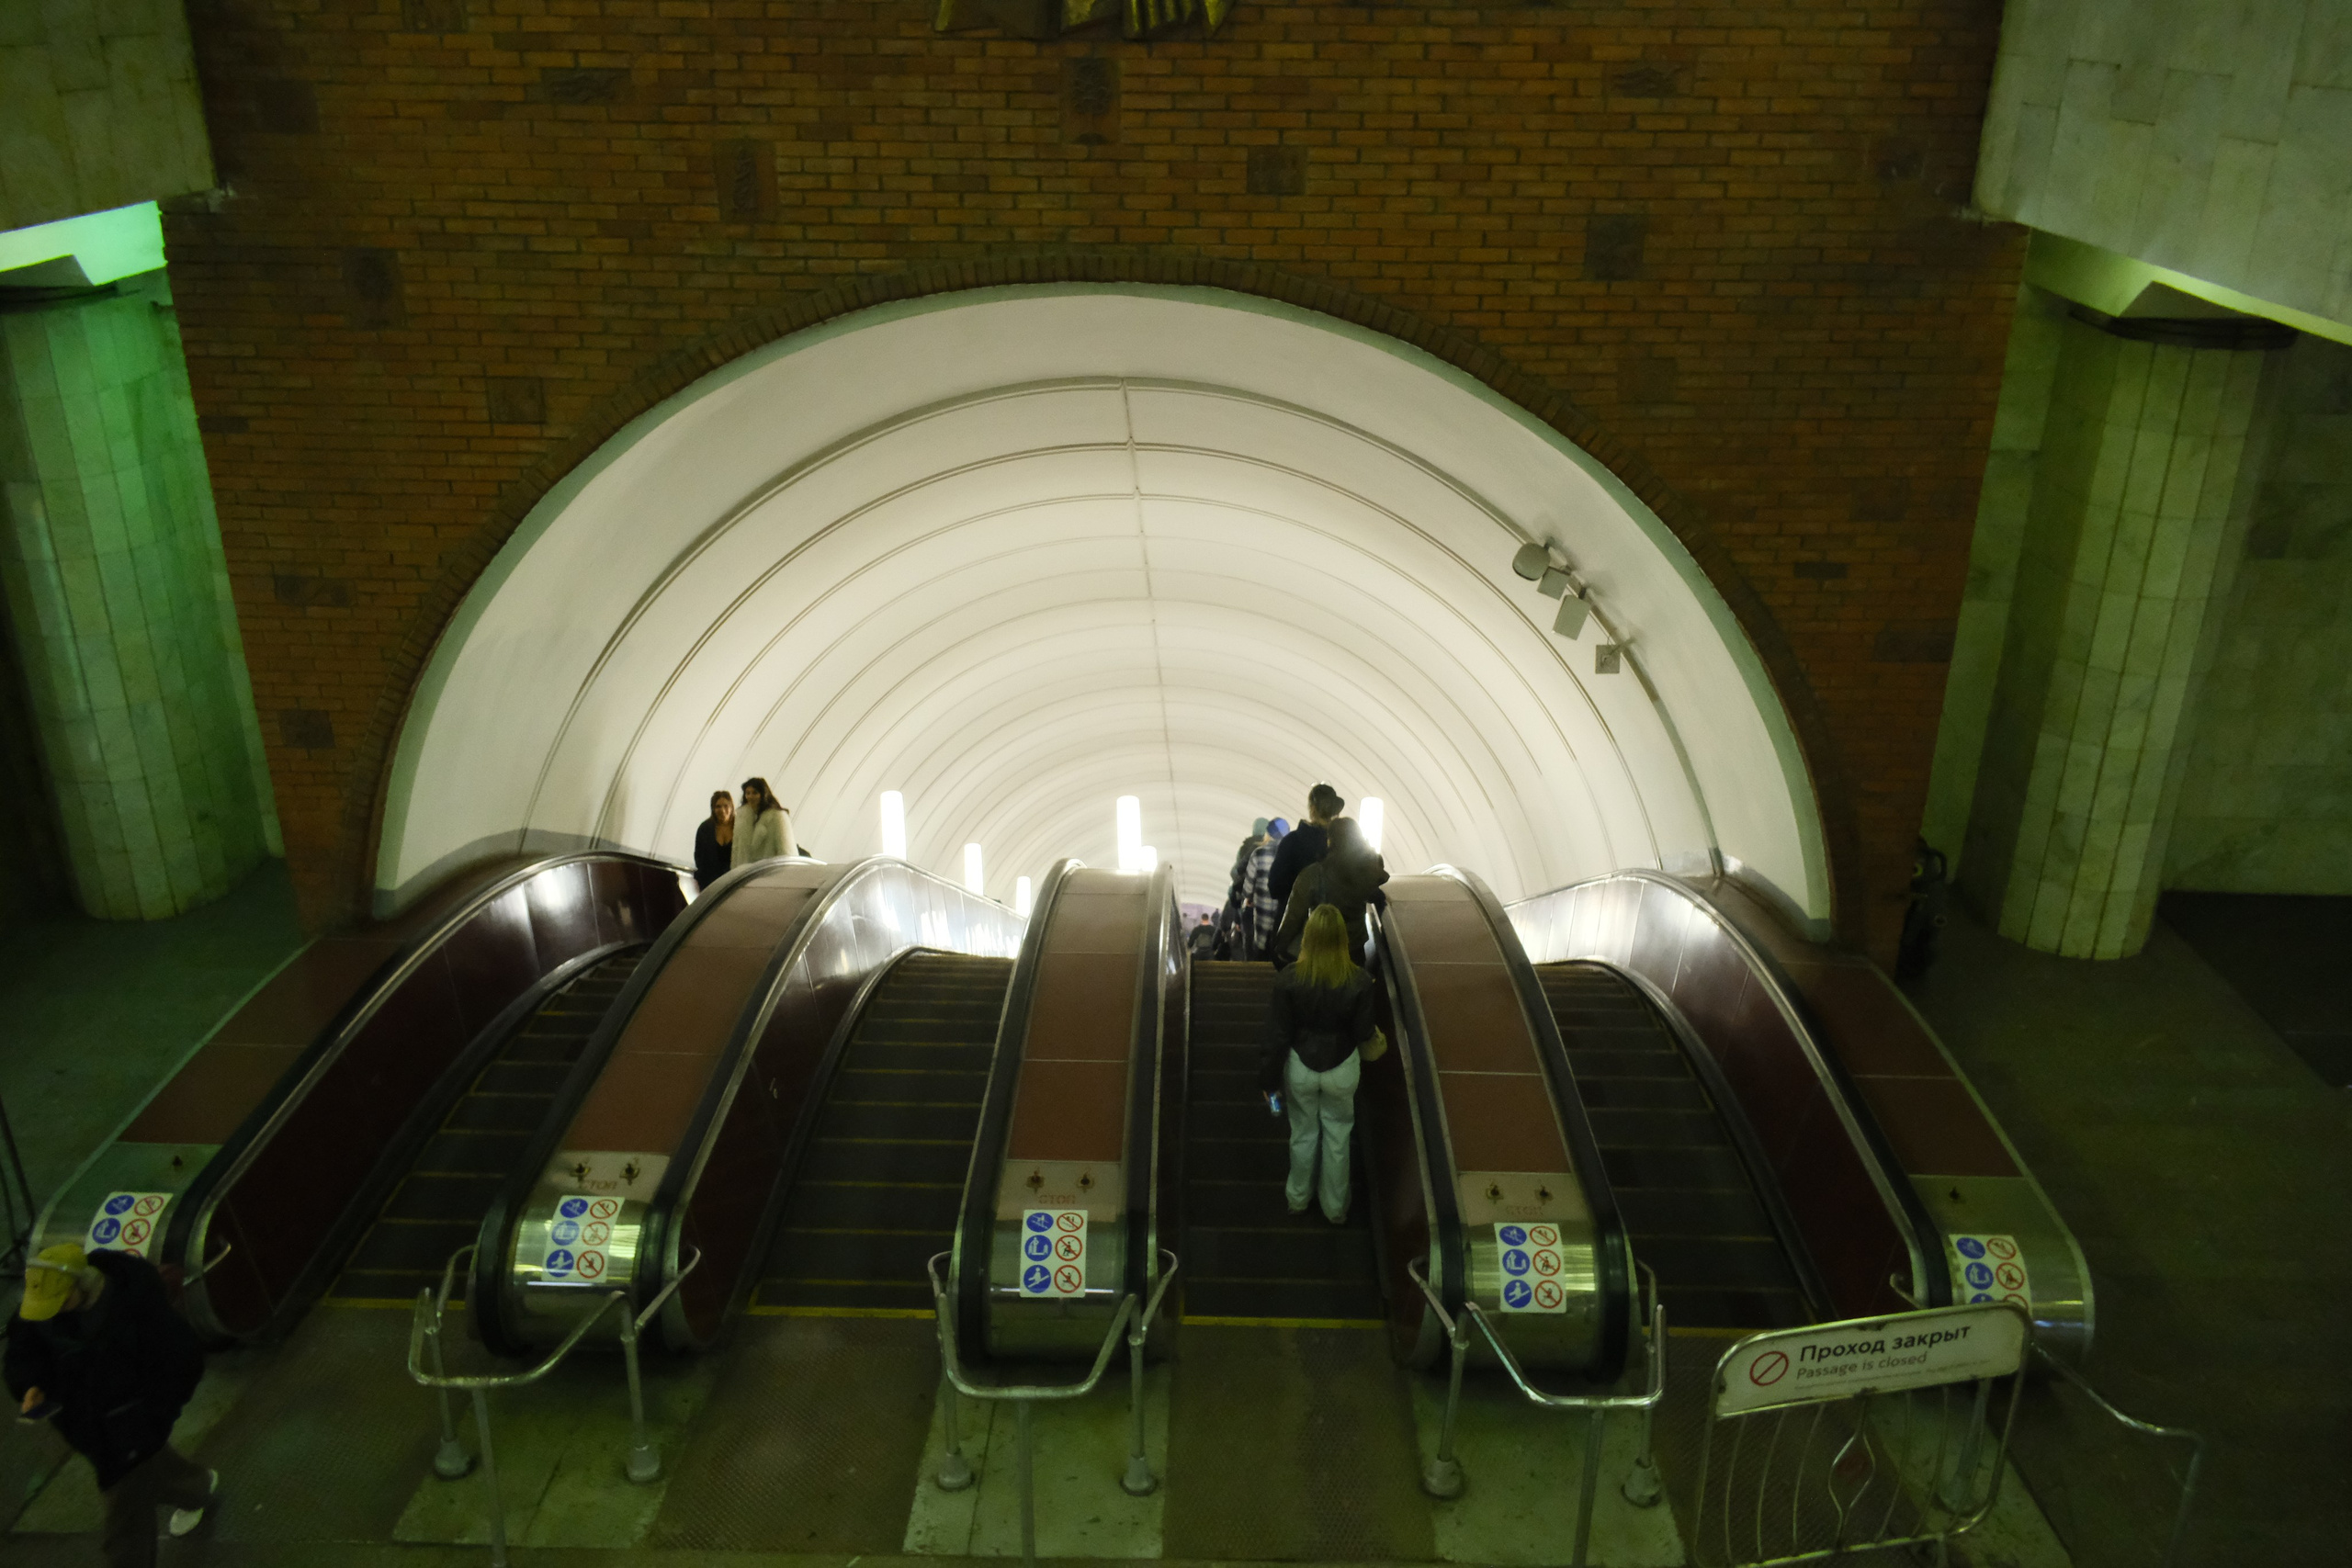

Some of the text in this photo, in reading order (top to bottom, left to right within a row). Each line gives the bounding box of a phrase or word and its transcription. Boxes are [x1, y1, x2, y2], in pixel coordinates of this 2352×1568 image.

[1038, 1194, 1076, 1205] СТОП
[1799, 1325, 1971, 1362] Проход закрыт
[1796, 1363, 1858, 1381] Passage
[1862, 1359, 1873, 1371] is
[1878, 1351, 1928, 1370] closed
